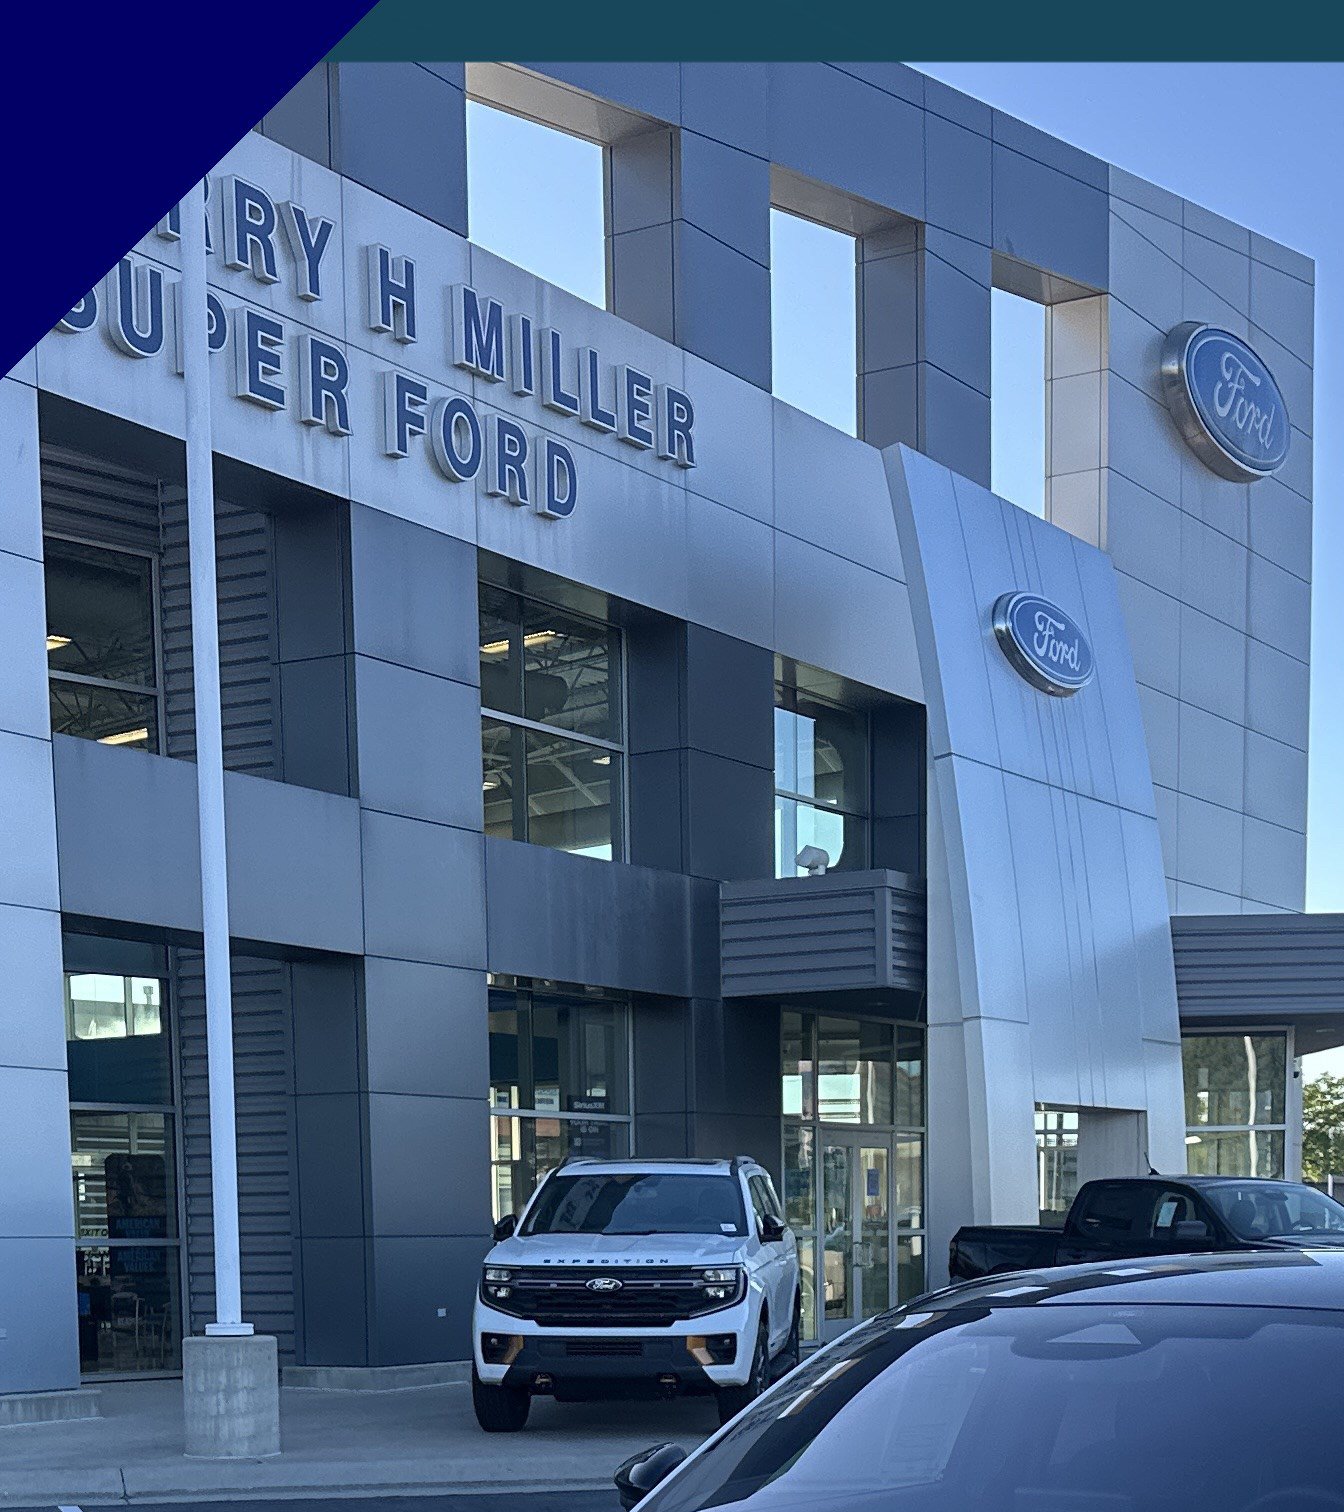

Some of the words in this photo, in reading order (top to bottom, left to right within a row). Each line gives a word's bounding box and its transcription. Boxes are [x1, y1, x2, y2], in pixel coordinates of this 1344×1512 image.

[368, 242, 418, 344] H
[451, 282, 697, 468] MILLER
[1213, 351, 1277, 451] Ford
[383, 369, 579, 520] FORD
[1033, 611, 1082, 673] Ford
